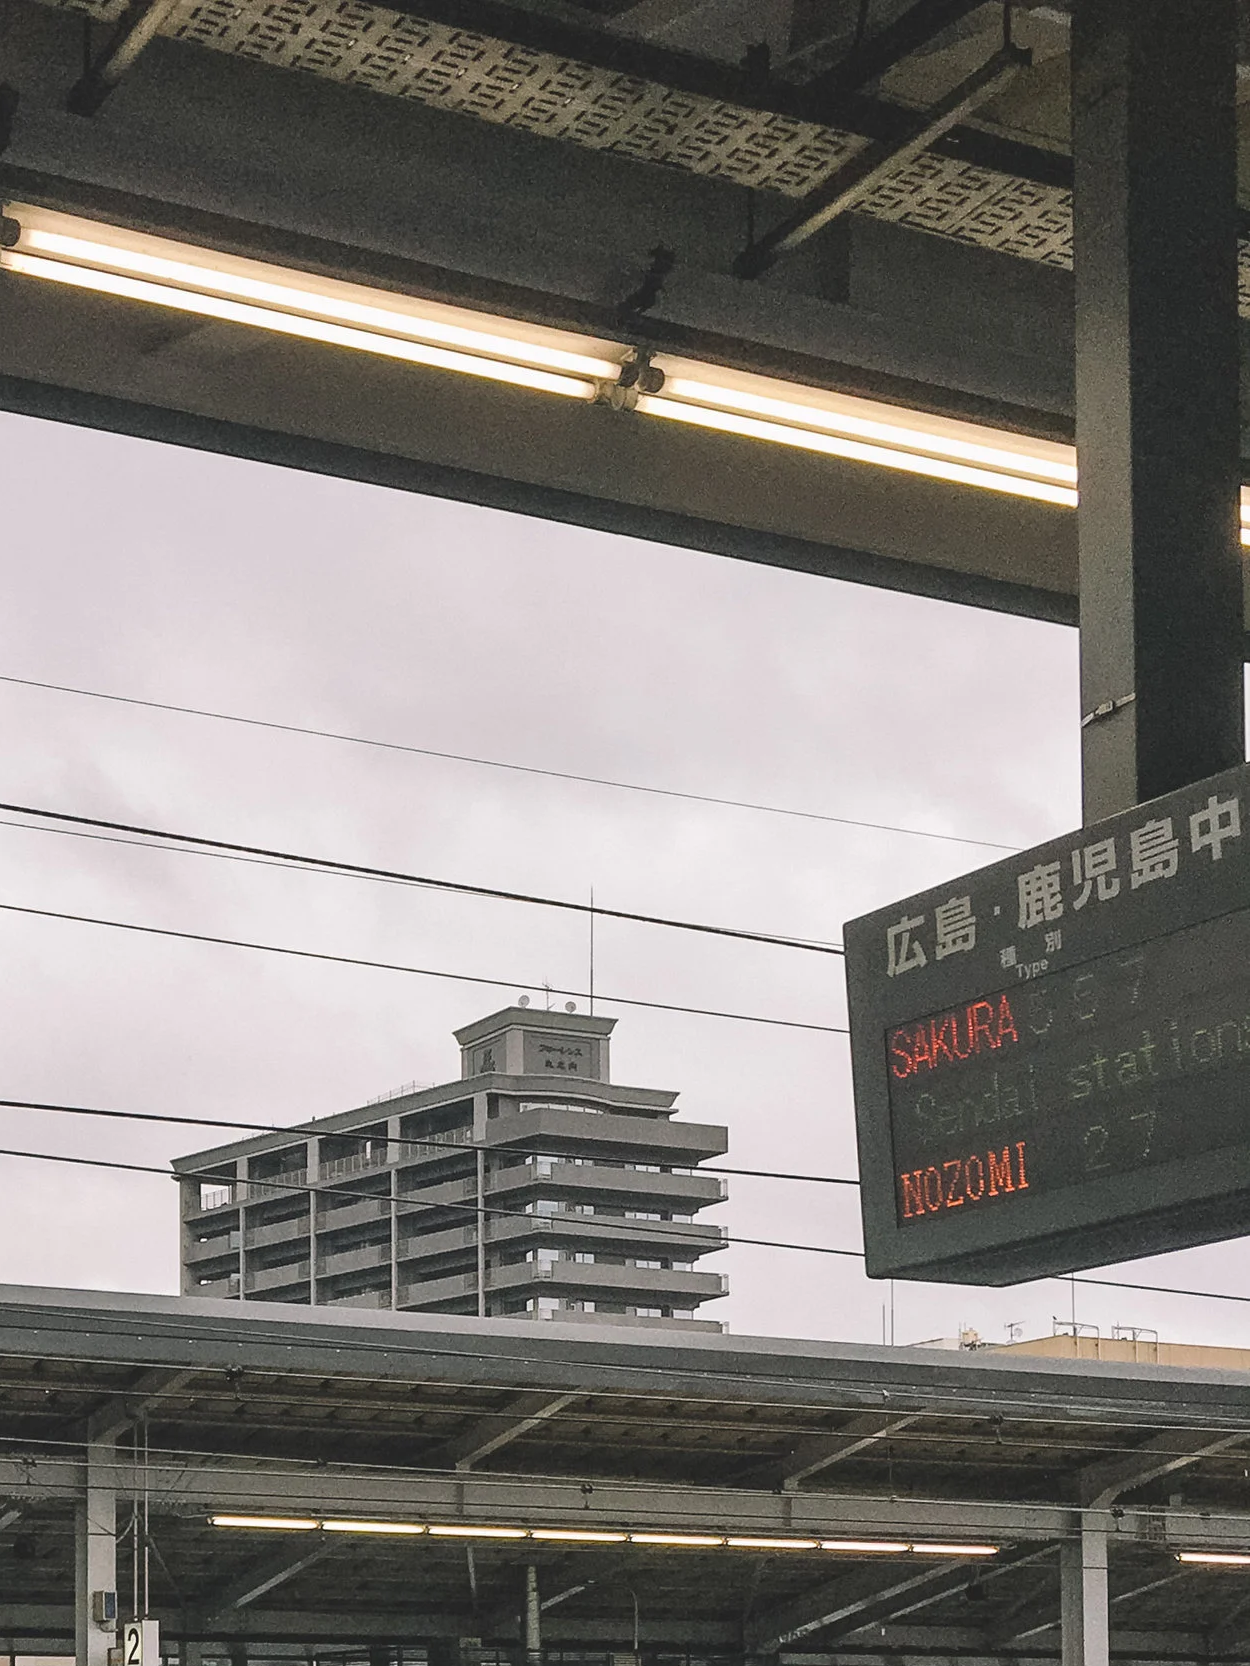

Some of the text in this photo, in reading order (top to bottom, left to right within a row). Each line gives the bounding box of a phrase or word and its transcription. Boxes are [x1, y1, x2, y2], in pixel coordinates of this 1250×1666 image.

[1015, 957, 1049, 980] Type
[892, 994, 1019, 1080] SAKURA
[900, 1141, 1029, 1219] NOZOMI
[127, 1627, 140, 1666] 2
